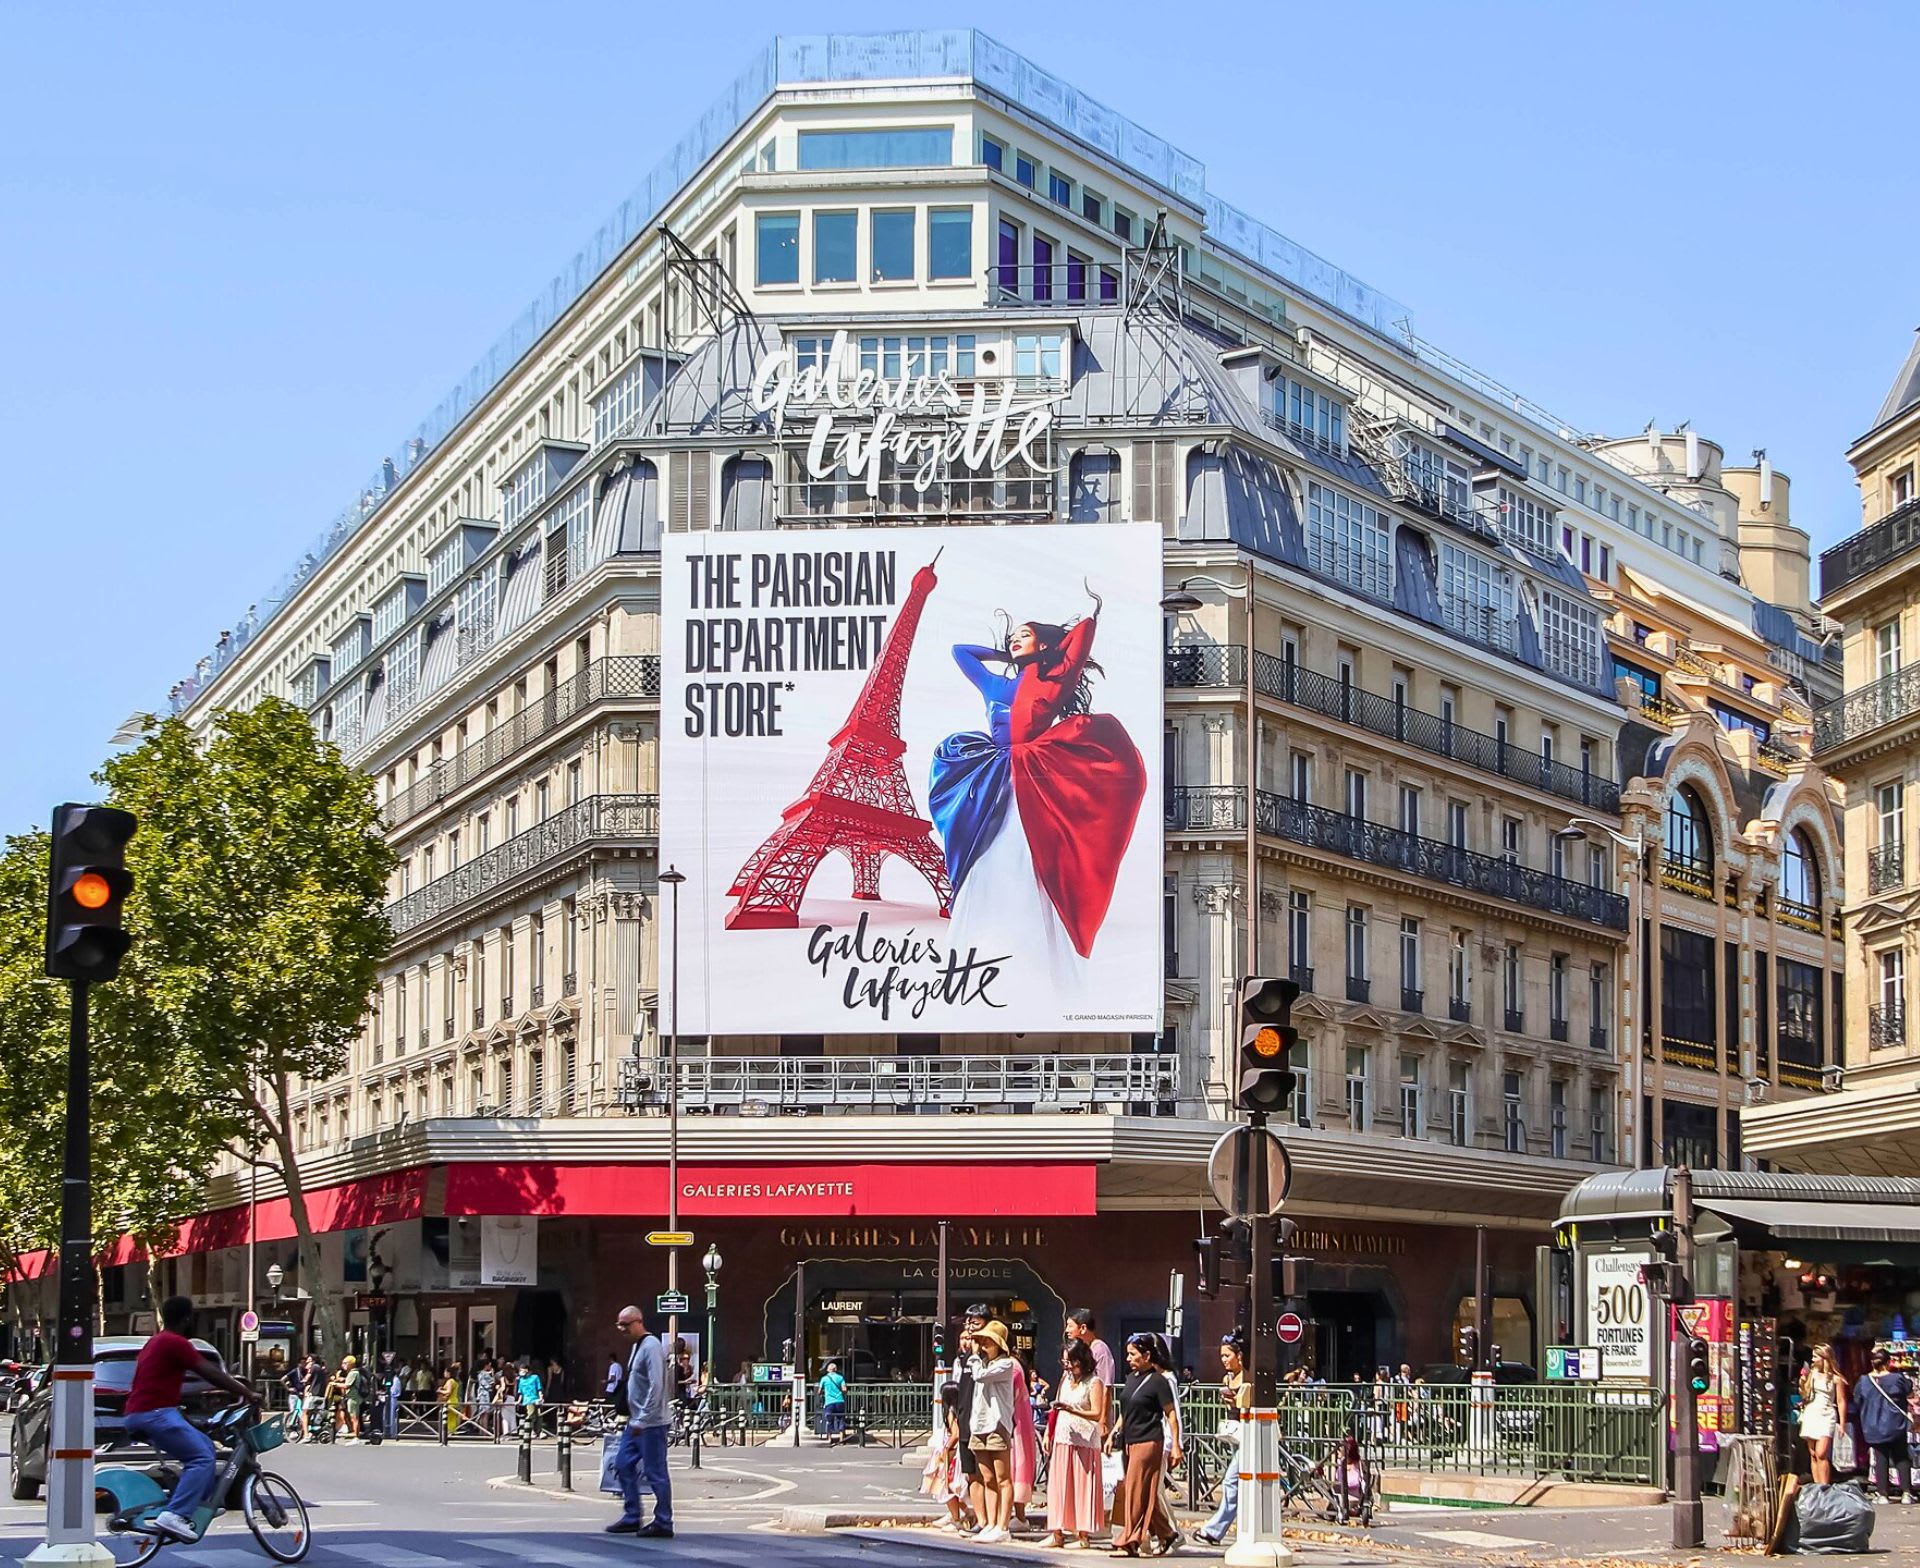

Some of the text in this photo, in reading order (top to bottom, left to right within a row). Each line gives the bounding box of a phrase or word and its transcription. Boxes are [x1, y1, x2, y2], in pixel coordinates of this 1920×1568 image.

[751, 330, 961, 432] Galeries
[806, 381, 1071, 497] Lafayette
[686, 551, 896, 609] THE PARISIAN
[685, 615, 887, 673] DEPARTMENT
[808, 911, 942, 978] Galeries
[843, 947, 1013, 1021] Lafayette
[682, 1183, 853, 1198] GALERIES LAFAYETTE
[780, 1227, 1048, 1247] GALERIES LAAYETTE
[903, 1267, 924, 1278] LA
[821, 1301, 863, 1311] LAURENT
[1597, 1284, 1643, 1325] 500
[1597, 1328, 1644, 1344] FORTUNES
[1611, 1344, 1638, 1356] FRANCE
